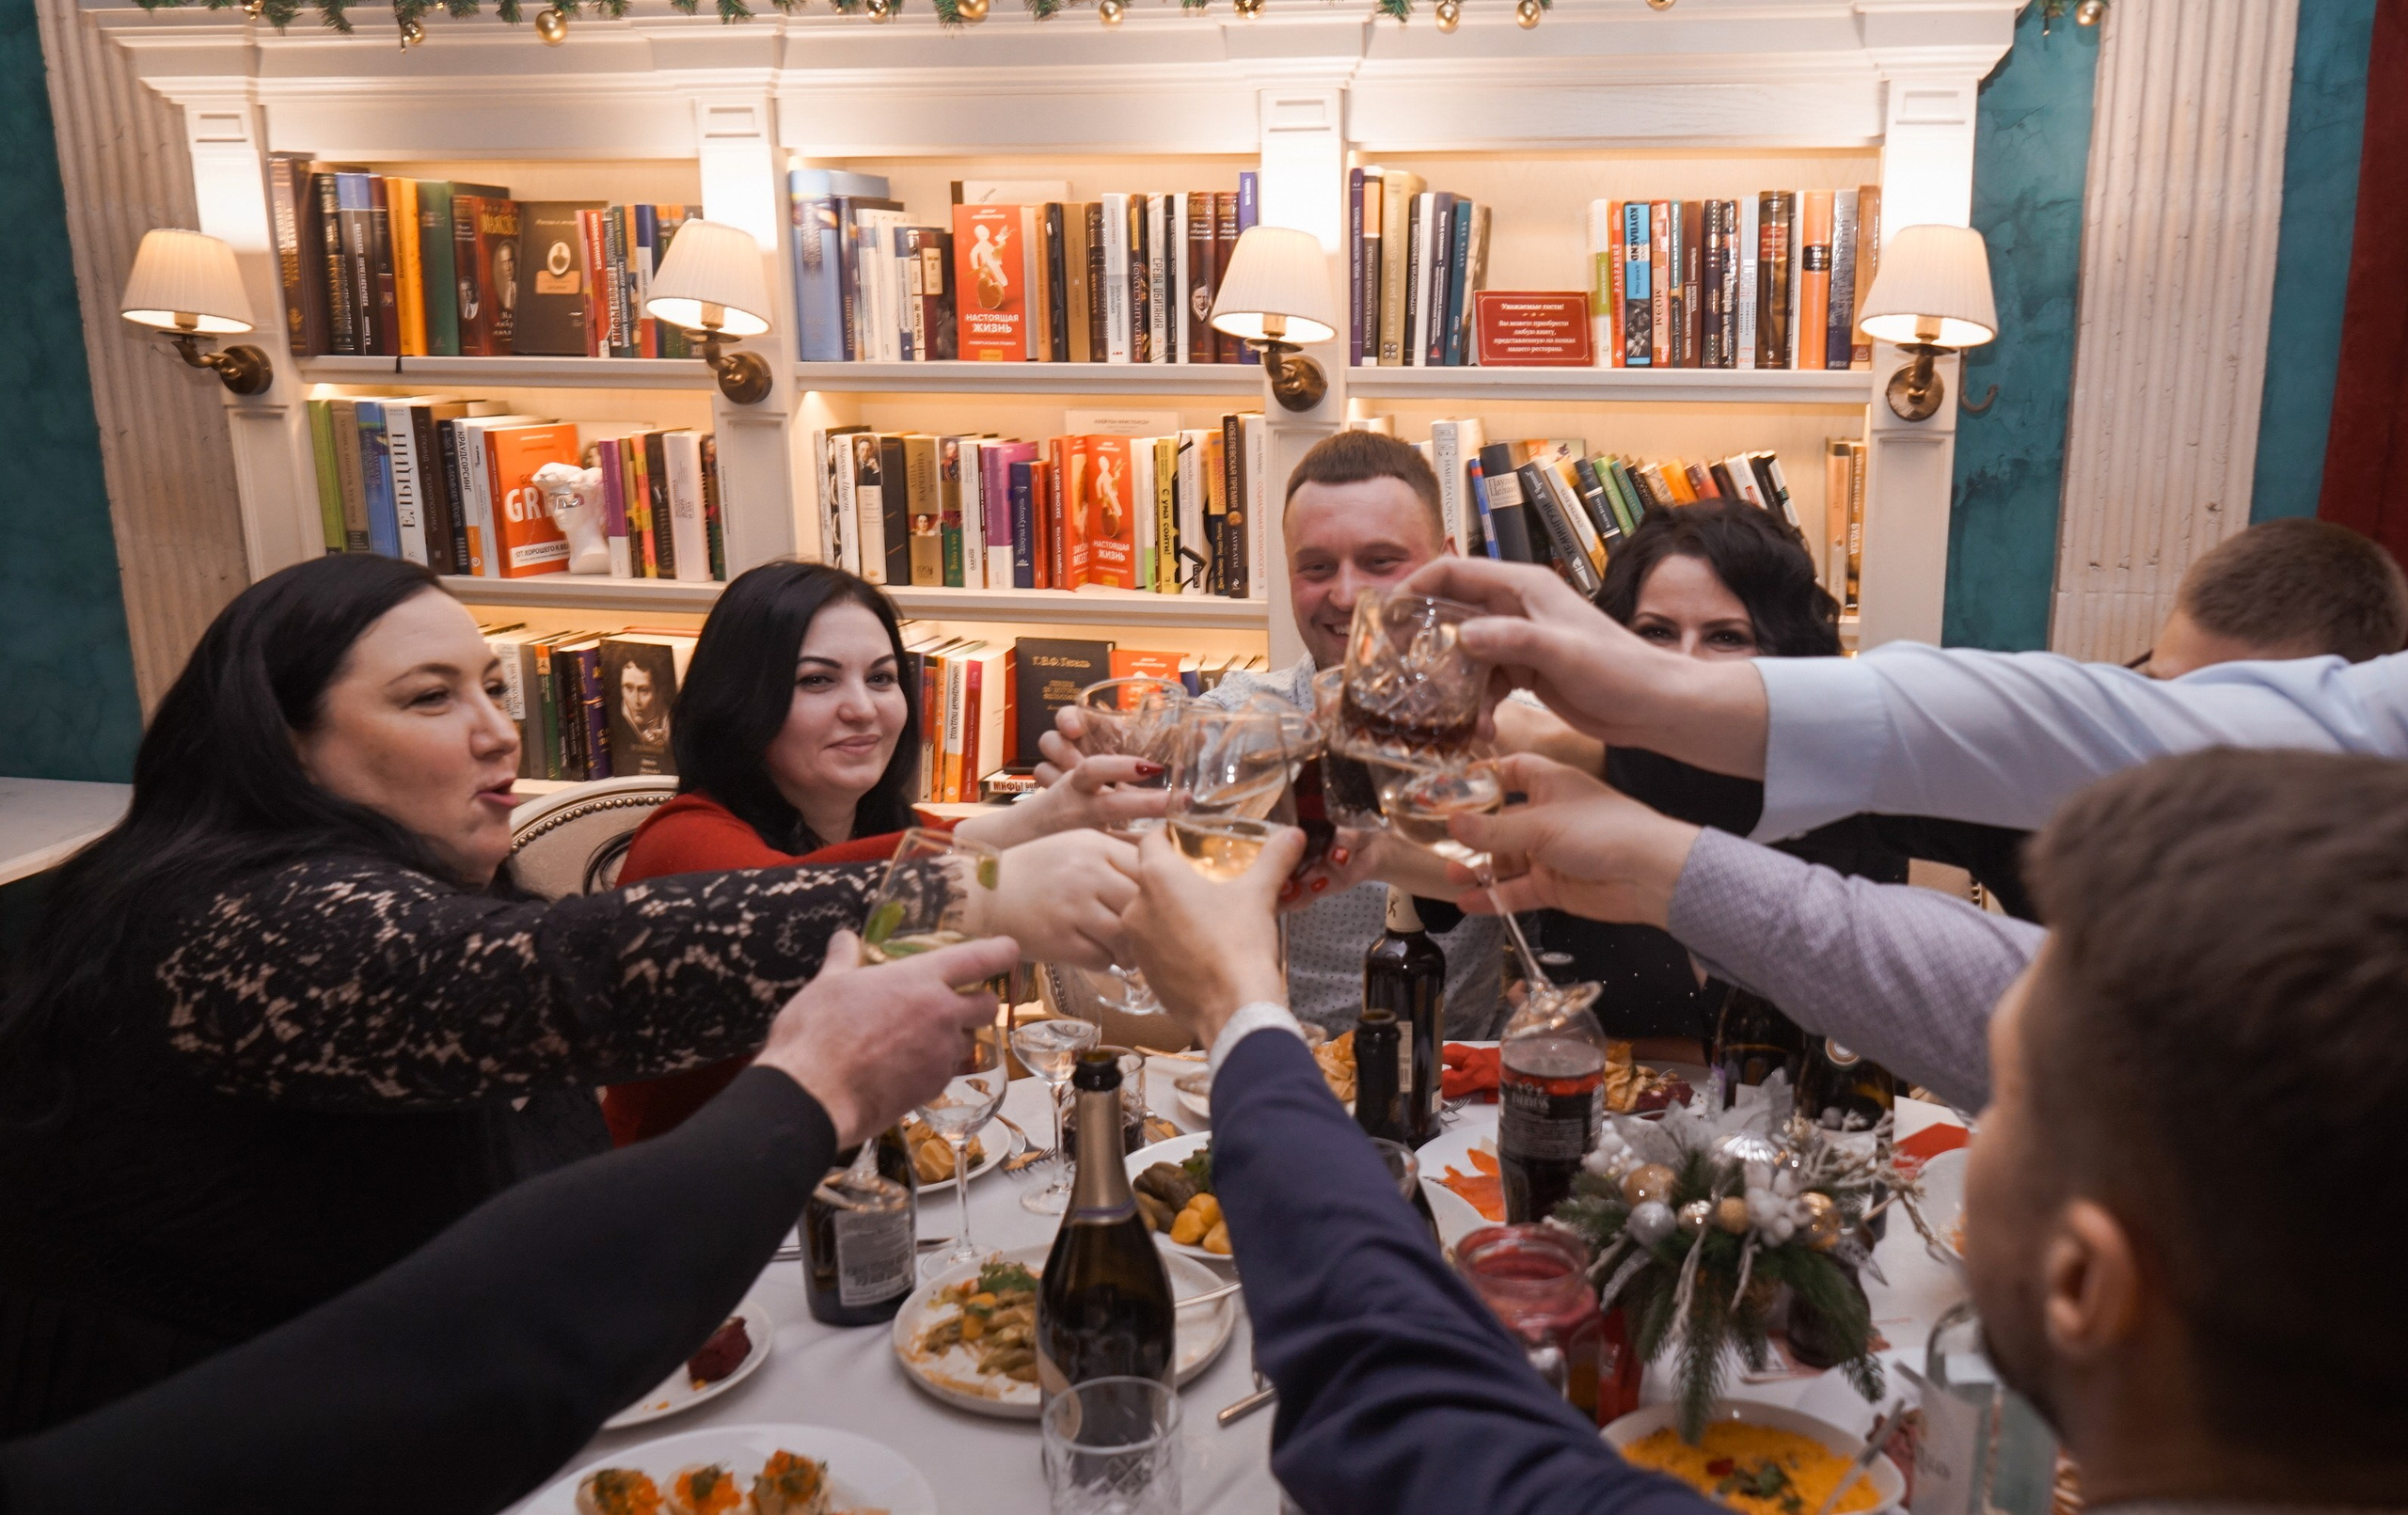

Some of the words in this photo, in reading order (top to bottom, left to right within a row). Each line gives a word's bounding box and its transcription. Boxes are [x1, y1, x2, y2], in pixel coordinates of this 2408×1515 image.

[354, 223, 364, 254] ИСКУССТВО
[394, 209, 404, 254] маркетинга
[590, 213, 600, 242] РОССИЯ
[593, 242, 602, 270] ЕДИНАЯ
[1388, 232, 1400, 260] будет
[357, 257, 369, 307] ИЗОБРАЗИТЕЛЬНОЕ
[618, 260, 626, 287] ХАРАКТЕР
[1152, 257, 1163, 283] СРЕДА
[1612, 244, 1621, 292] РАЗУМНЫЙ
[620, 287, 629, 323] ФИЗИЧЕСКИХ
[1115, 284, 1123, 301] Третья
[1133, 261, 1141, 318] ПРЕСТОЛОВ
[1389, 281, 1398, 299] раз
[964, 313, 1018, 322] НАСТОЯЩАЯ
[1115, 302, 1123, 341] промышленная
[1153, 287, 1164, 328] ОБИТАНИЯ
[1388, 302, 1397, 324] этот
[1655, 288, 1663, 325] МОЭМ
[611, 308, 622, 342] МИФЫ
[845, 295, 854, 351] НАВАЖДЕНИЕ
[972, 324, 1011, 333] ЖИЗНЬ
[1133, 320, 1142, 345] ИГРА
[1386, 326, 1395, 339] На
[457, 431, 471, 492] КРАУДСОРСИНГ
[839, 443, 848, 479] Марсель
[1228, 421, 1238, 475] НОБЕЛЕВСКАЯ
[391, 434, 416, 529] ЕЛЬЦИН
[420, 434, 430, 462] ЭТКИНД
[425, 473, 438, 532] ПСИХОПОЭТИКА
[909, 463, 917, 488] АННА
[917, 452, 927, 502] КАРЕНИНА
[1487, 478, 1516, 487] Пауль
[1489, 485, 1517, 497] Целан
[672, 479, 680, 517] ЭКОНОМИКА
[840, 481, 850, 512] Пруст
[1229, 476, 1239, 509] ПРЕМИЯ
[1256, 481, 1264, 530] СОЦИАЛЬНАЯ
[1443, 457, 1454, 533] ИМПЕРАТОРСКА
[1018, 497, 1026, 528] Гуссерль
[1162, 499, 1171, 519] ума
[1018, 528, 1027, 555] Эдмунд
[1163, 522, 1172, 555] сойти!
[1543, 501, 1576, 557] ХЕМИНГУЭЙ
[1849, 523, 1860, 555] БУДДА
[524, 546, 555, 556] ХОРОШЕГО
[1093, 539, 1131, 552] НАСТОЯЩАЯ
[1098, 549, 1126, 562] ЖИЗНЬ
[951, 665, 960, 710] КОМАНДНЫЙ
[950, 711, 958, 740] ПОДХОД
[992, 780, 1022, 792] МИФЫ
